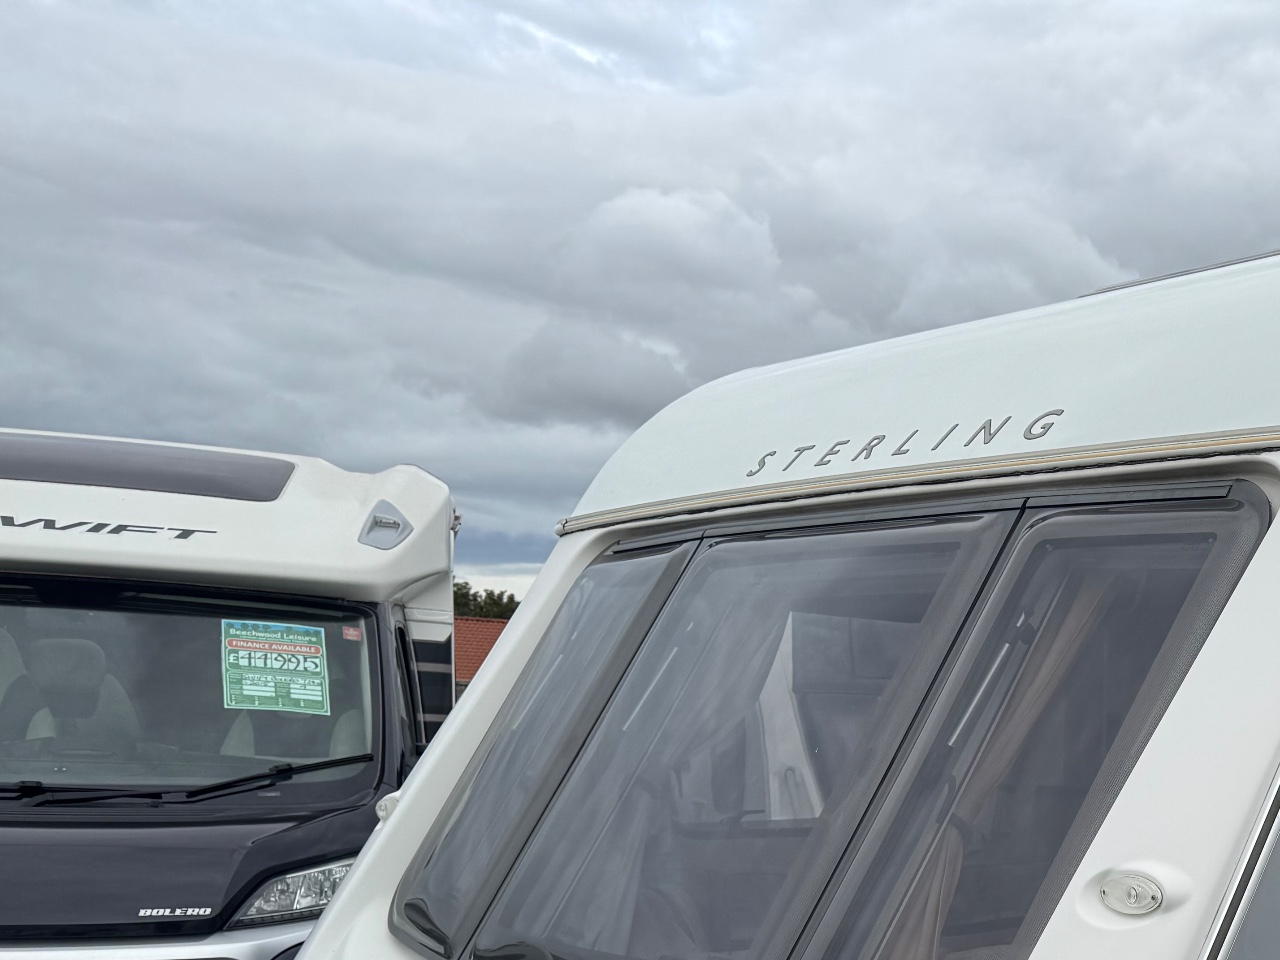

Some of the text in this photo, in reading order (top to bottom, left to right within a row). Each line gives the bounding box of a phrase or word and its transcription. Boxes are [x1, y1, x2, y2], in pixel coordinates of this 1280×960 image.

[745, 408, 1065, 477] STERLING
[229, 628, 281, 639] Beechwood
[283, 632, 317, 642] Leisure
[232, 640, 317, 653] FINANCE AVAILABLE
[138, 903, 212, 916] BOLERO
